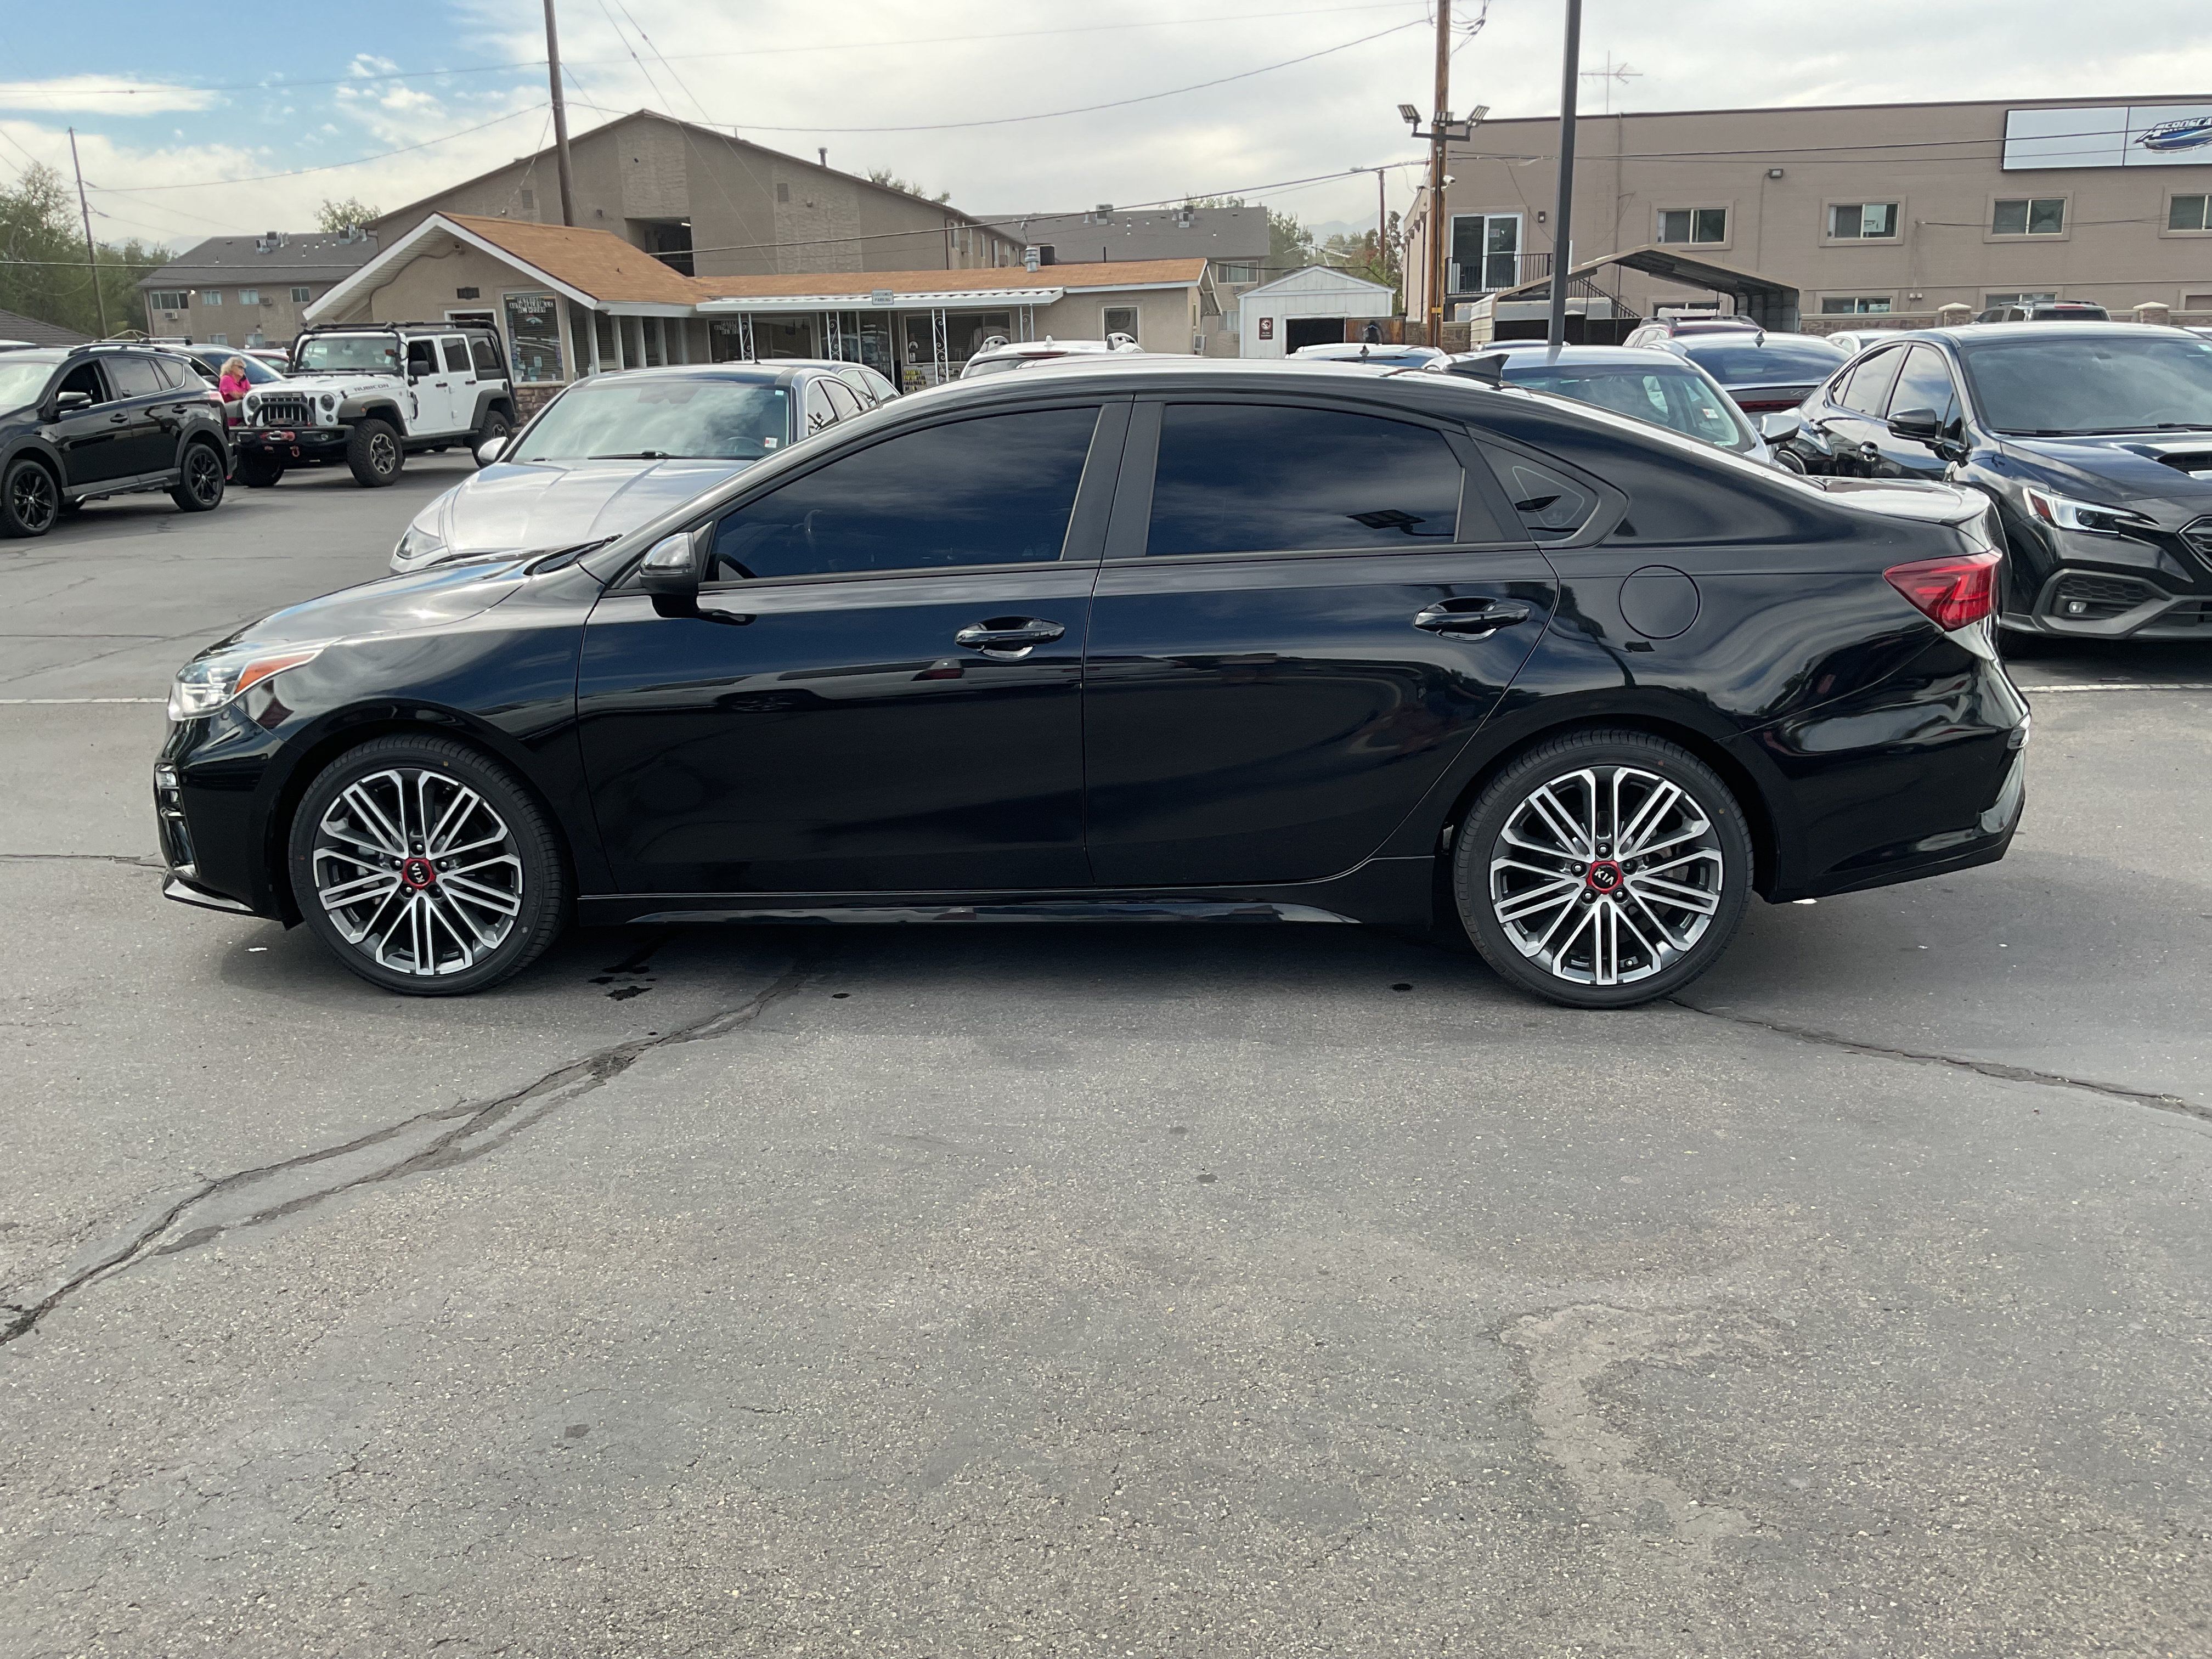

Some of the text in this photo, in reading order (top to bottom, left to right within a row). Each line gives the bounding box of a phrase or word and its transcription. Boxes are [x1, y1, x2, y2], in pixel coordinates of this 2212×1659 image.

[354, 383, 389, 392] RUBICON
[412, 863, 425, 883] KIA
[1594, 868, 1614, 885] KIA
